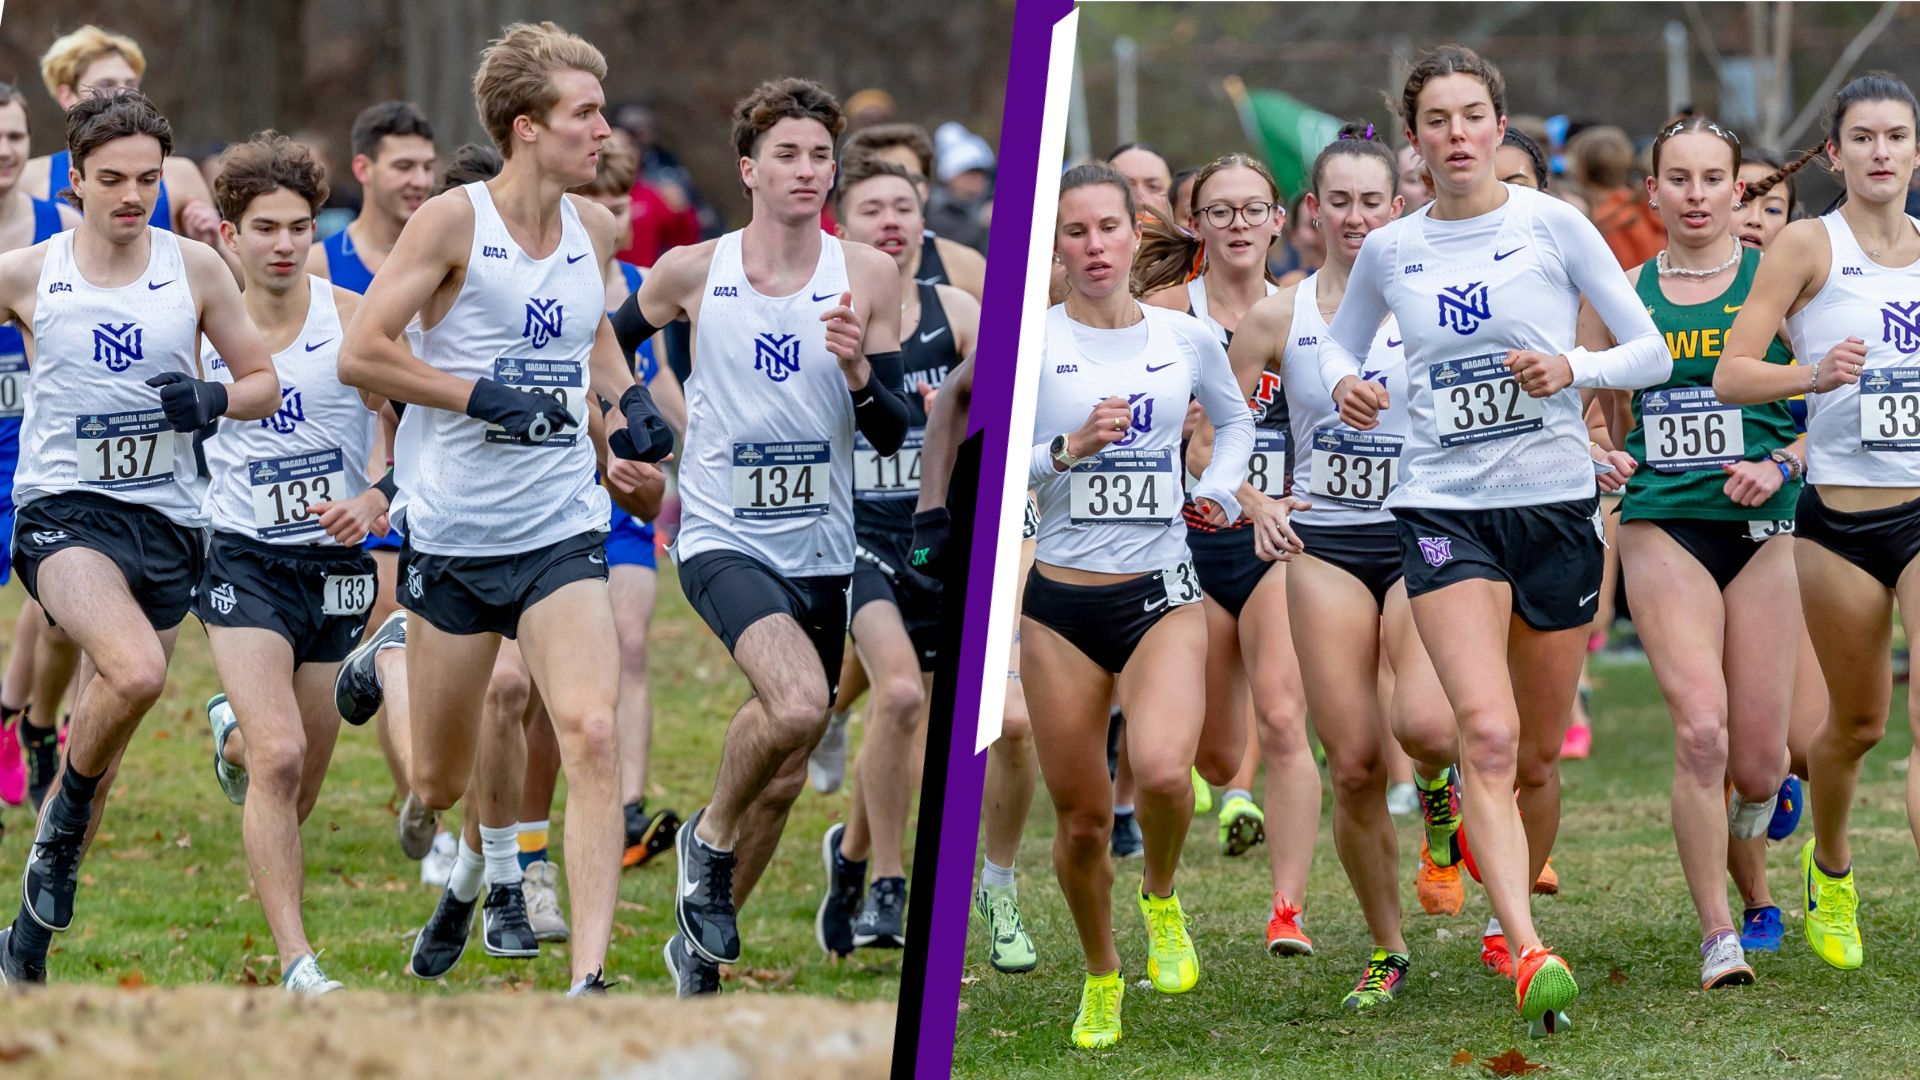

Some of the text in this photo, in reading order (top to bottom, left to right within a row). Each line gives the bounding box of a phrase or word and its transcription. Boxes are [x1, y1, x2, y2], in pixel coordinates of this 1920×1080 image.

[482, 246, 508, 260] UAA
[1404, 263, 1424, 274] UAA
[1842, 266, 1864, 276] UAA
[49, 282, 73, 294] UAA
[713, 286, 738, 298] UAA
[1298, 336, 1318, 347] UAA
[524, 362, 550, 372] NIAGARA
[550, 364, 576, 373] REGIONAL
[1056, 364, 1078, 374] UAA
[1462, 356, 1492, 371] NIAGARA
[1670, 390, 1700, 400] NIAGARA
[1450, 378, 1525, 430] 332
[108, 411, 166, 425] NIAGARA REGIONA
[1344, 434, 1372, 444] NIAGARA
[1658, 413, 1726, 458] 356
[764, 444, 824, 454] NIAGARA REGIONAL
[1104, 450, 1165, 458] NIAGARA REGIONAL
[95, 434, 158, 480] 137
[279, 452, 336, 470] NIAGARA REGIONAL
[1326, 454, 1391, 500] 331
[748, 465, 814, 508] 134
[268, 476, 332, 525] 133
[1088, 474, 1159, 516] 334
[336, 578, 366, 610] 133
